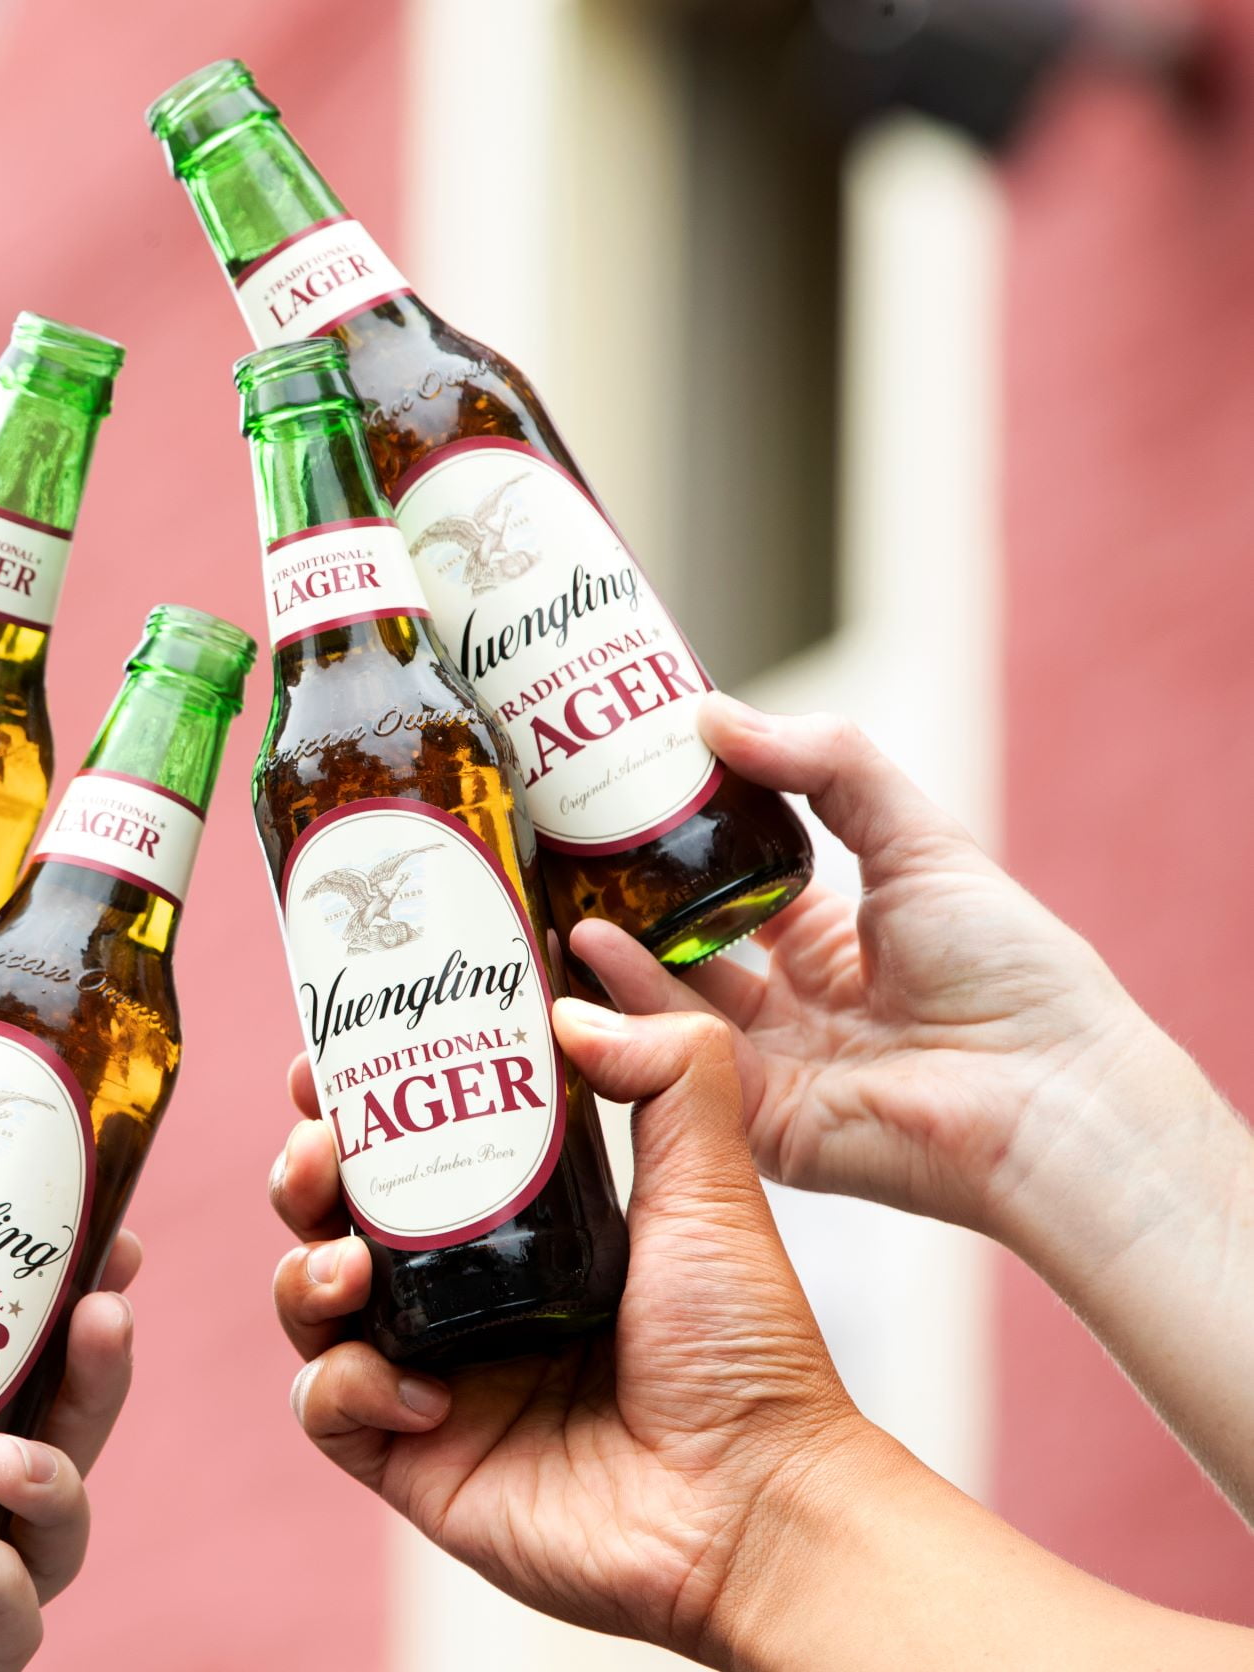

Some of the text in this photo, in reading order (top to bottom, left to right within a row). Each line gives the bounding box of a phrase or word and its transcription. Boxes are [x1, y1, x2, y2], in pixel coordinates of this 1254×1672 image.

[268, 253, 374, 329] LAGER
[269, 243, 350, 294] TRADITIONAL
[273, 562, 382, 617] LAGER
[276, 549, 365, 583] TRADITIONAL
[498, 628, 653, 724] RADITIONAL
[558, 731, 697, 816] Original Amber Beer
[55, 809, 161, 860] LAGER
[300, 937, 531, 1066] Yuengling
[332, 1027, 511, 1093] TRADITIONAL
[329, 1055, 547, 1164] LAGER
[369, 1142, 516, 1197] Original Amber Beer
